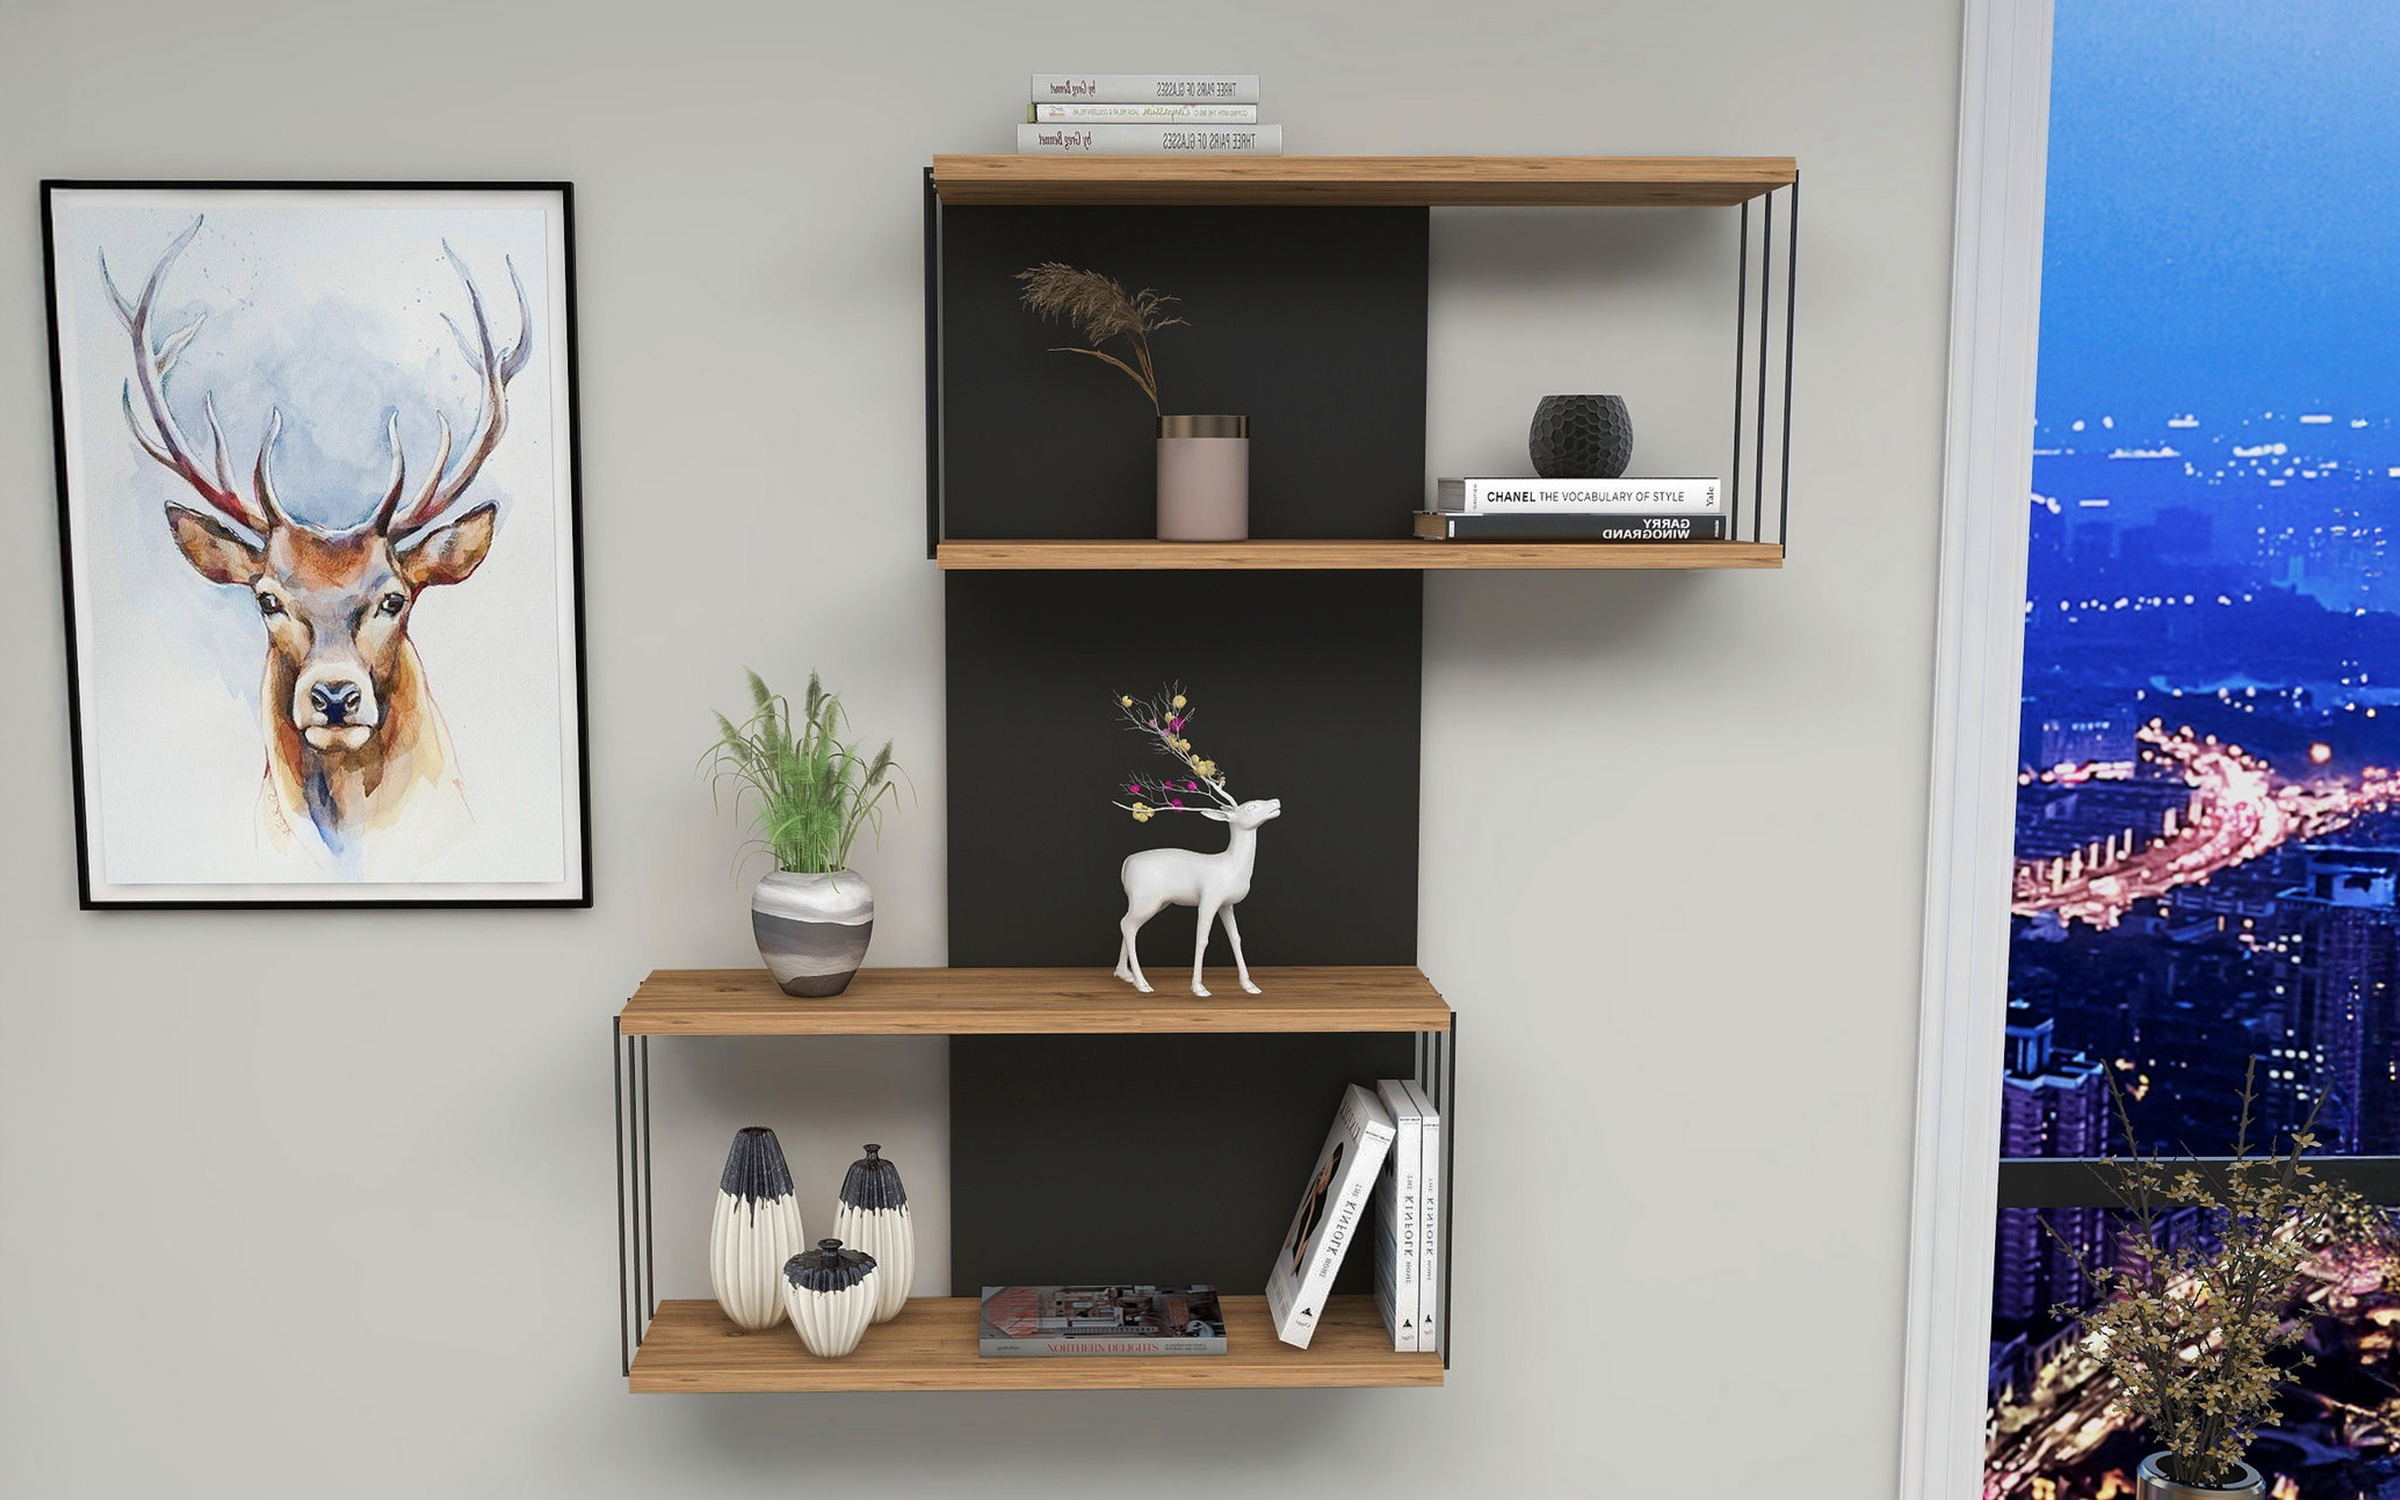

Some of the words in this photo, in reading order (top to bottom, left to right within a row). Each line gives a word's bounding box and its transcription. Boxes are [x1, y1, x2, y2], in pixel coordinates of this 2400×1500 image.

[1486, 491, 1536, 503] CHANEL
[1539, 491, 1559, 502] THE
[1561, 491, 1633, 502] VOCABULARY
[1635, 491, 1651, 502] OF
[1652, 491, 1685, 502] STYLE
[1706, 486, 1715, 507] Yale
[1047, 1343, 1105, 1353] NORTHERN
[1107, 1343, 1159, 1352] DELIGHTS
